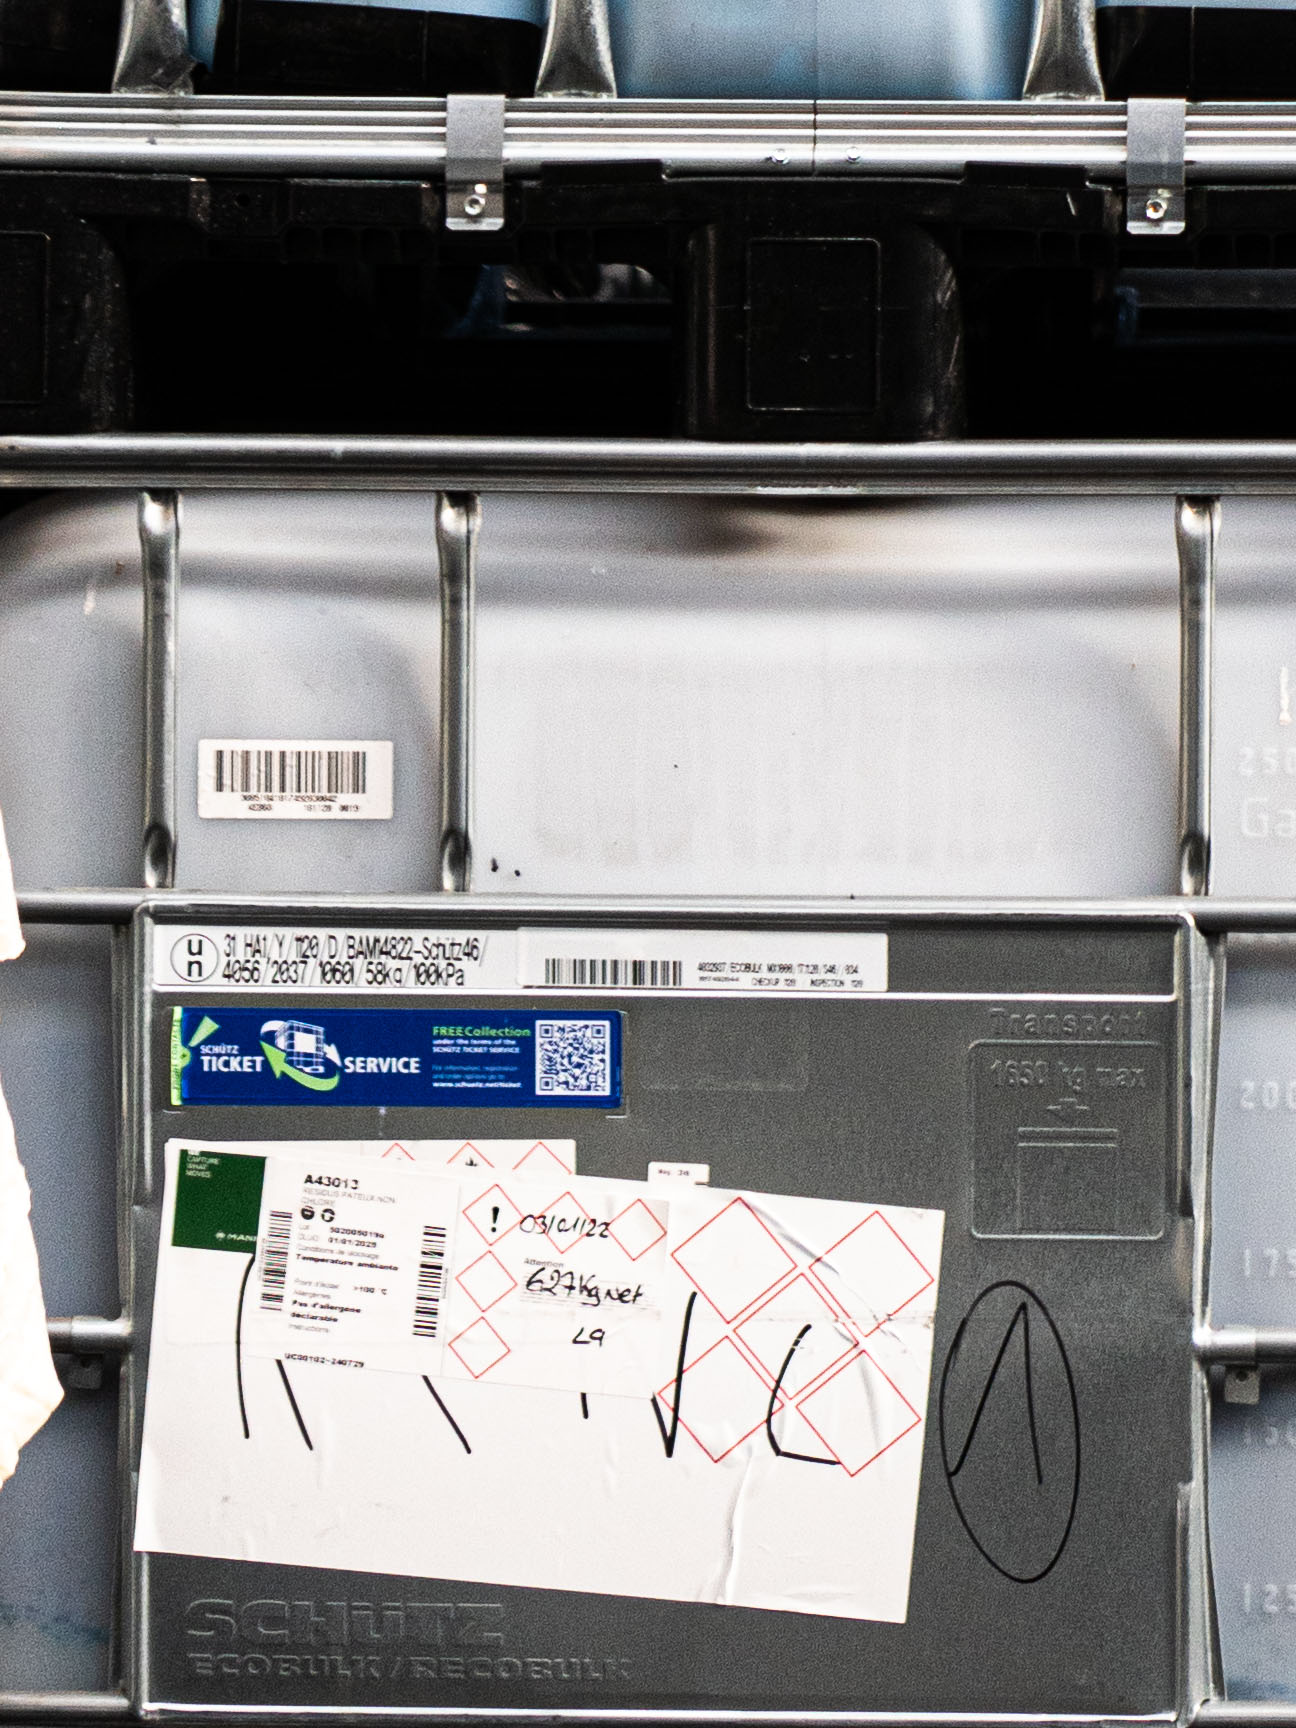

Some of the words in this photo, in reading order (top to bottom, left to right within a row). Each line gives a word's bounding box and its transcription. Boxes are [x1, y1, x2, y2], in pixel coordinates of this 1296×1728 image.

[432, 1026, 461, 1037] FREE
[464, 1026, 531, 1037] Collection
[200, 1042, 239, 1055] SCHÜTZ
[463, 1046, 488, 1054] TICKET
[488, 1046, 520, 1054] SERVICE
[199, 1055, 265, 1073] TICKET
[344, 1056, 420, 1074] SERVICE
[1096, 1067, 1144, 1086] max
[303, 1174, 359, 1190] A43013
[356, 1261, 399, 1272] ambiante
[523, 1256, 565, 1268] Attention
[292, 1299, 308, 1308] Pas
